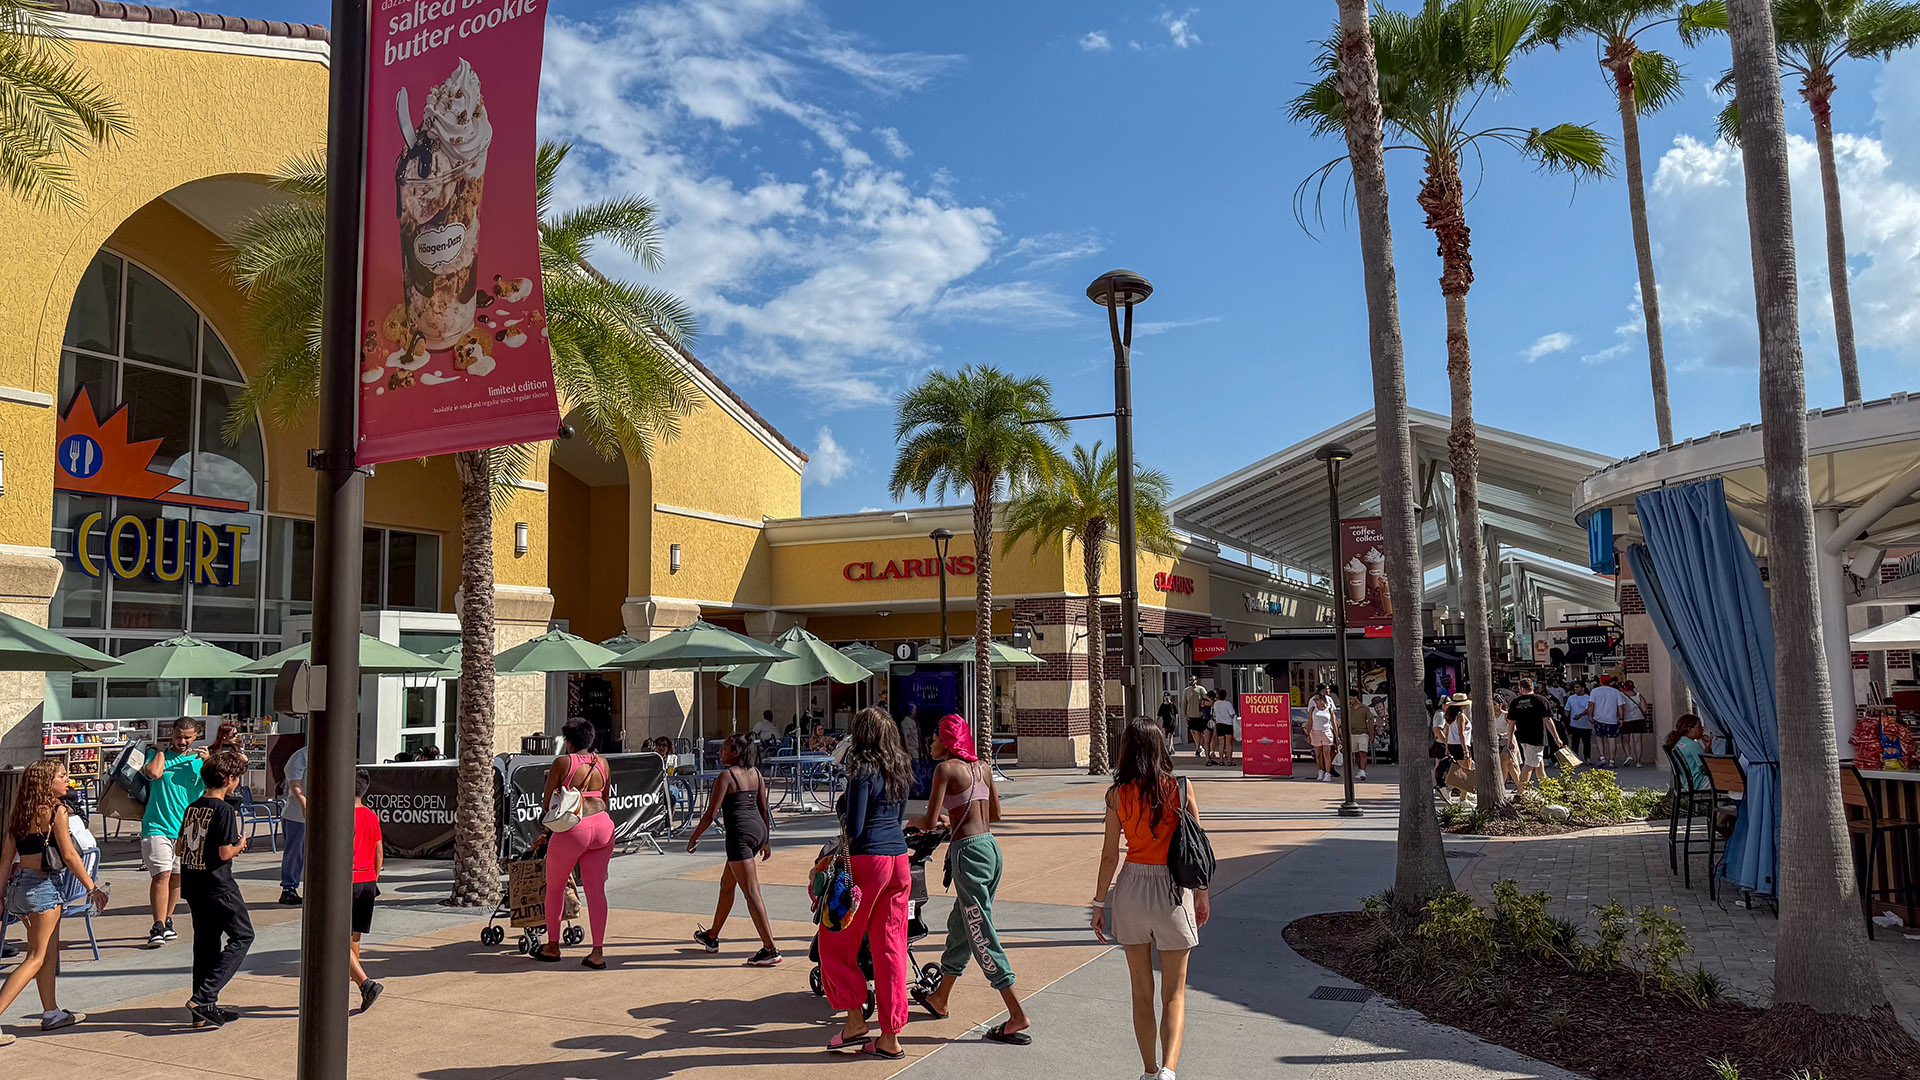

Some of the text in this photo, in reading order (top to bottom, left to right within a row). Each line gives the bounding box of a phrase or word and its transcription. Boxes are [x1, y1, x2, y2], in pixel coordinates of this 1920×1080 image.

[388, 0, 456, 36] salted
[384, 0, 537, 66] butter cookie
[488, 379, 548, 397] limited edition
[459, 401, 473, 410] small
[482, 398, 500, 407] regular
[514, 394, 531, 403] regular
[532, 390, 550, 399] shown
[1352, 527, 1376, 536] coffee
[74, 511, 250, 587] COURT
[843, 555, 976, 581] CLARINS
[1154, 571, 1194, 594] CLARINS
[1570, 635, 1606, 645] CITIZEN
[1245, 695, 1283, 704] DISCOUNT
[1249, 705, 1279, 714] TICKETS
[366, 794, 446, 809] STORES OPEN
[516, 793, 539, 808] ALL
